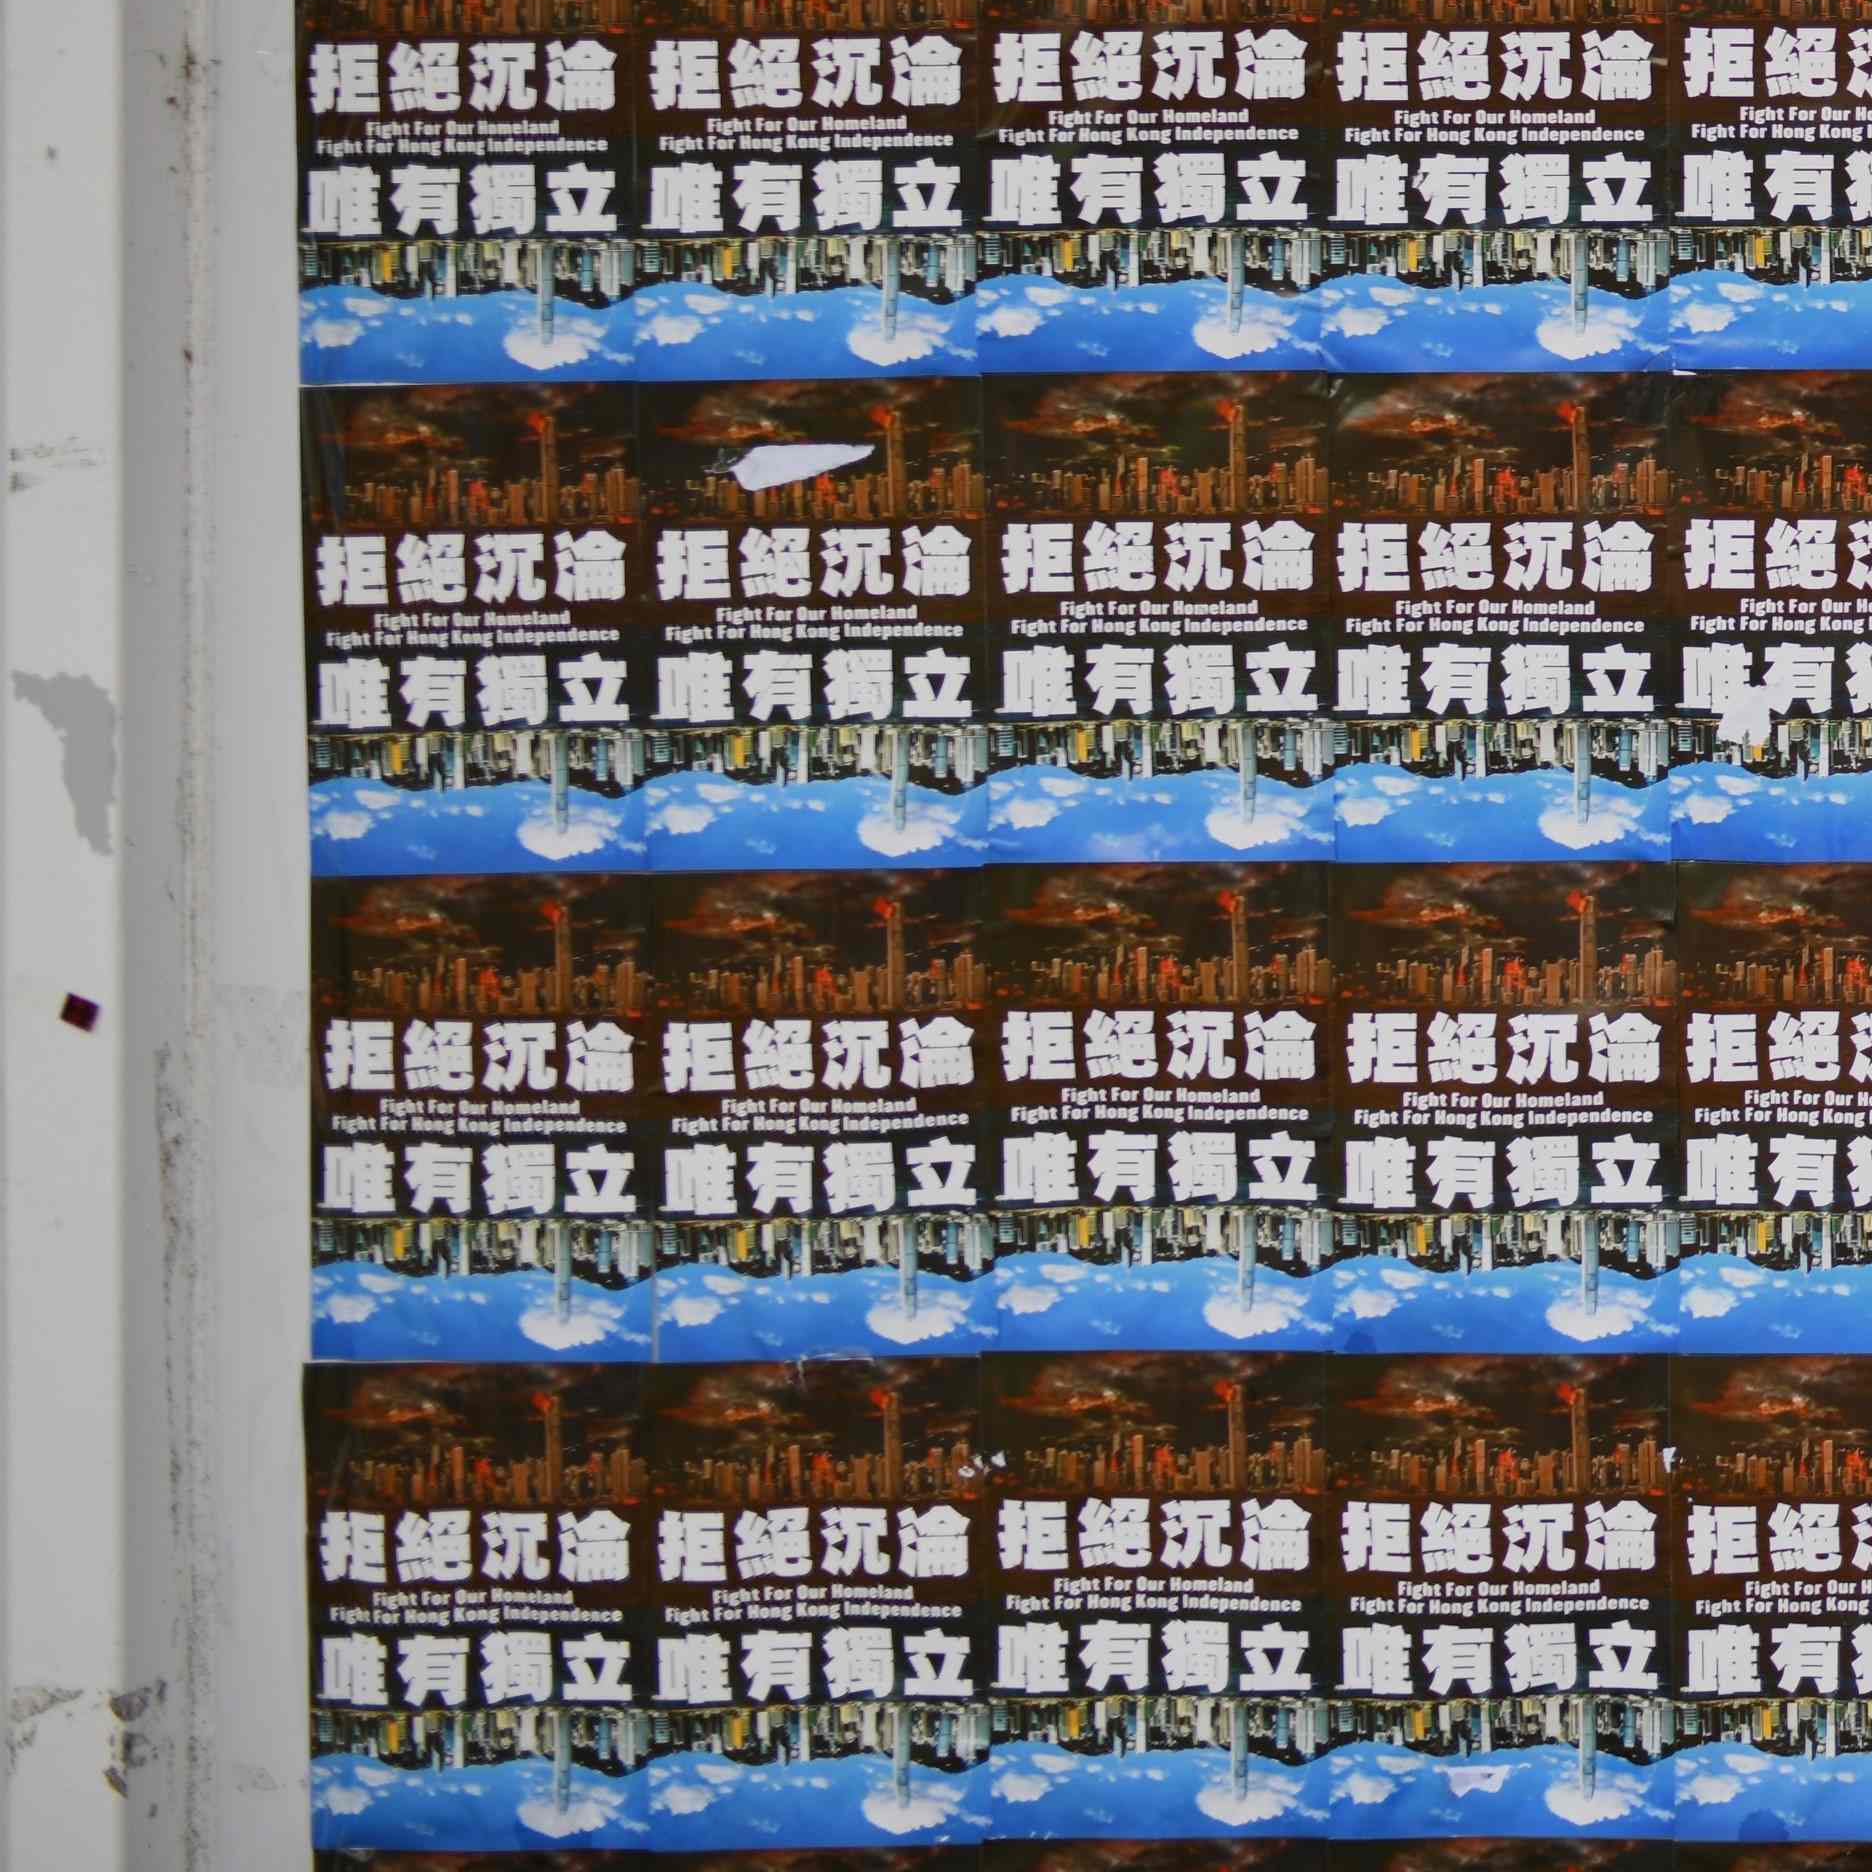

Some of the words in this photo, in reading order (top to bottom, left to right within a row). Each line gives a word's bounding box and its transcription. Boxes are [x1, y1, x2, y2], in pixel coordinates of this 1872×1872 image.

[310, 41, 616, 113] 拒絕沉淪
[1336, 30, 1653, 101] 拒絕沉淪
[308, 163, 617, 236] 唯有獨立
[1334, 152, 1652, 225] 唯有獨立
[657, 526, 971, 600] 拒絕沉淪
[655, 648, 972, 722] 唯有獨立
[307, 1012, 634, 1099] 拒絕沉淪
[1347, 1012, 1661, 1084] 拒絕沉淪
[319, 1142, 636, 1214] 唯有獨立
[1345, 1134, 1663, 1208] 唯有獨立
[1341, 1501, 1656, 1573] 拒絕沉淪
[1339, 1620, 1658, 1695] 唯有獨立
